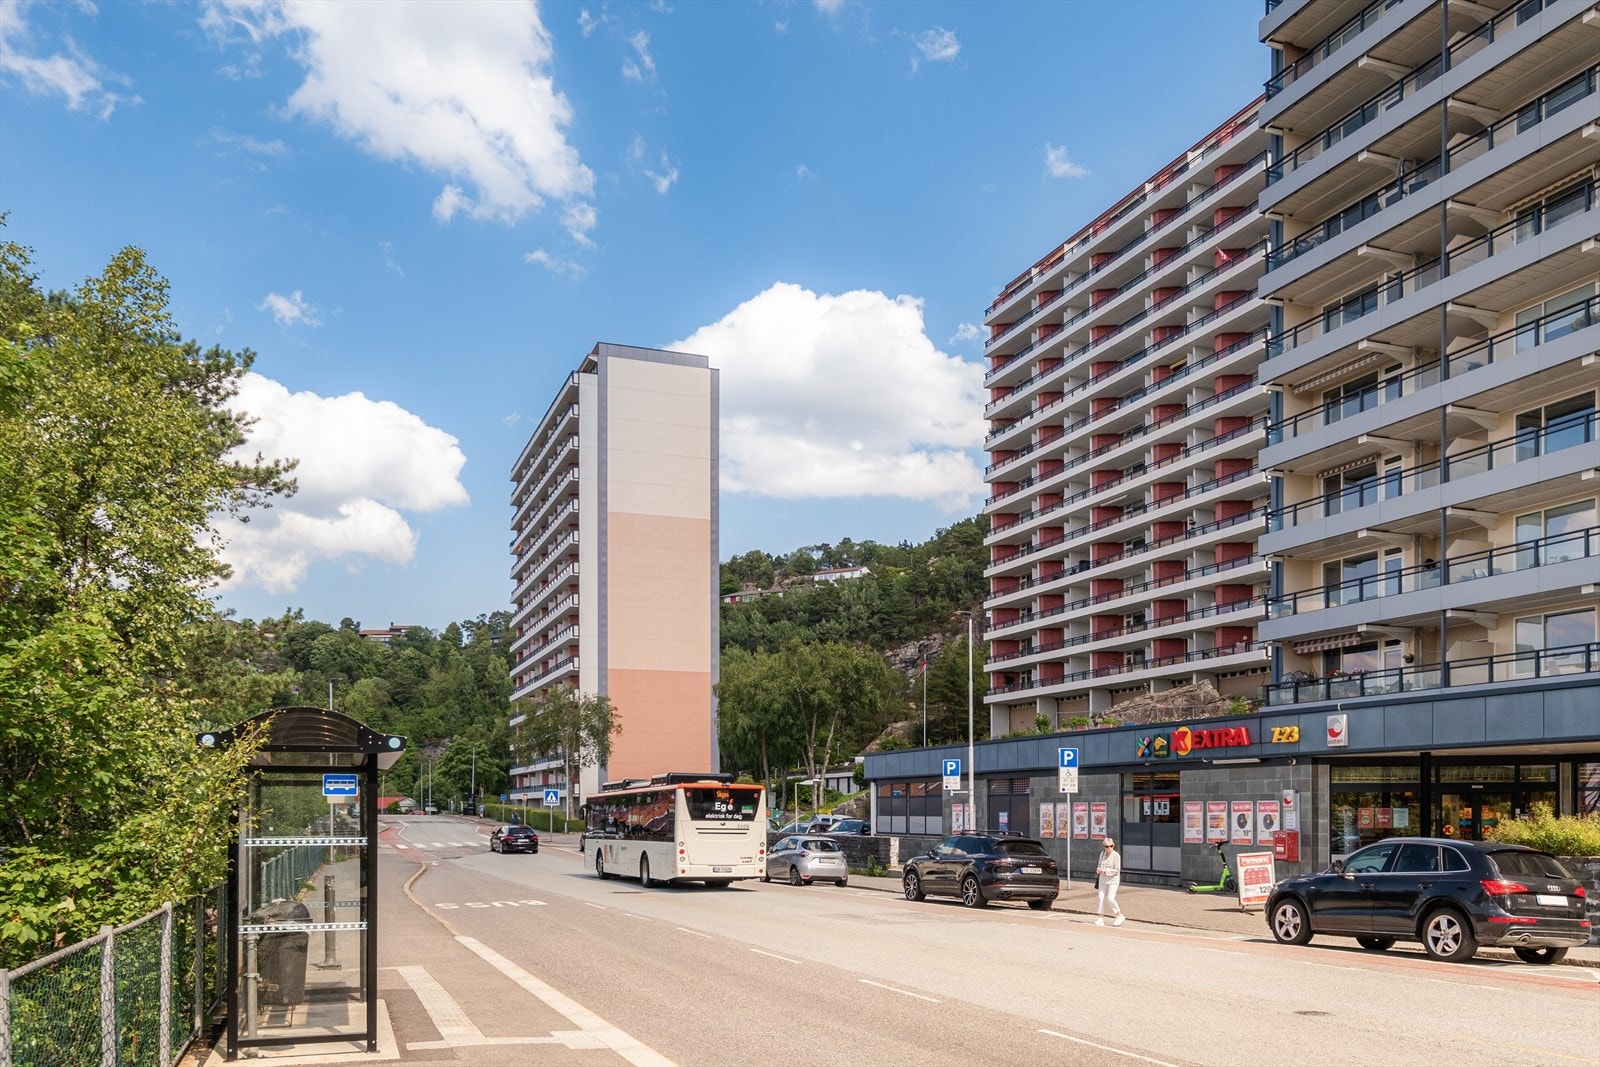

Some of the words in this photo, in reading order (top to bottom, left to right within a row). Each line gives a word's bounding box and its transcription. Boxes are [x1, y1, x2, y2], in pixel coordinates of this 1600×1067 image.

[1191, 726, 1250, 748] EXTRA
[1063, 750, 1074, 766] P
[946, 761, 956, 775] P
[715, 802, 726, 812] Eg
